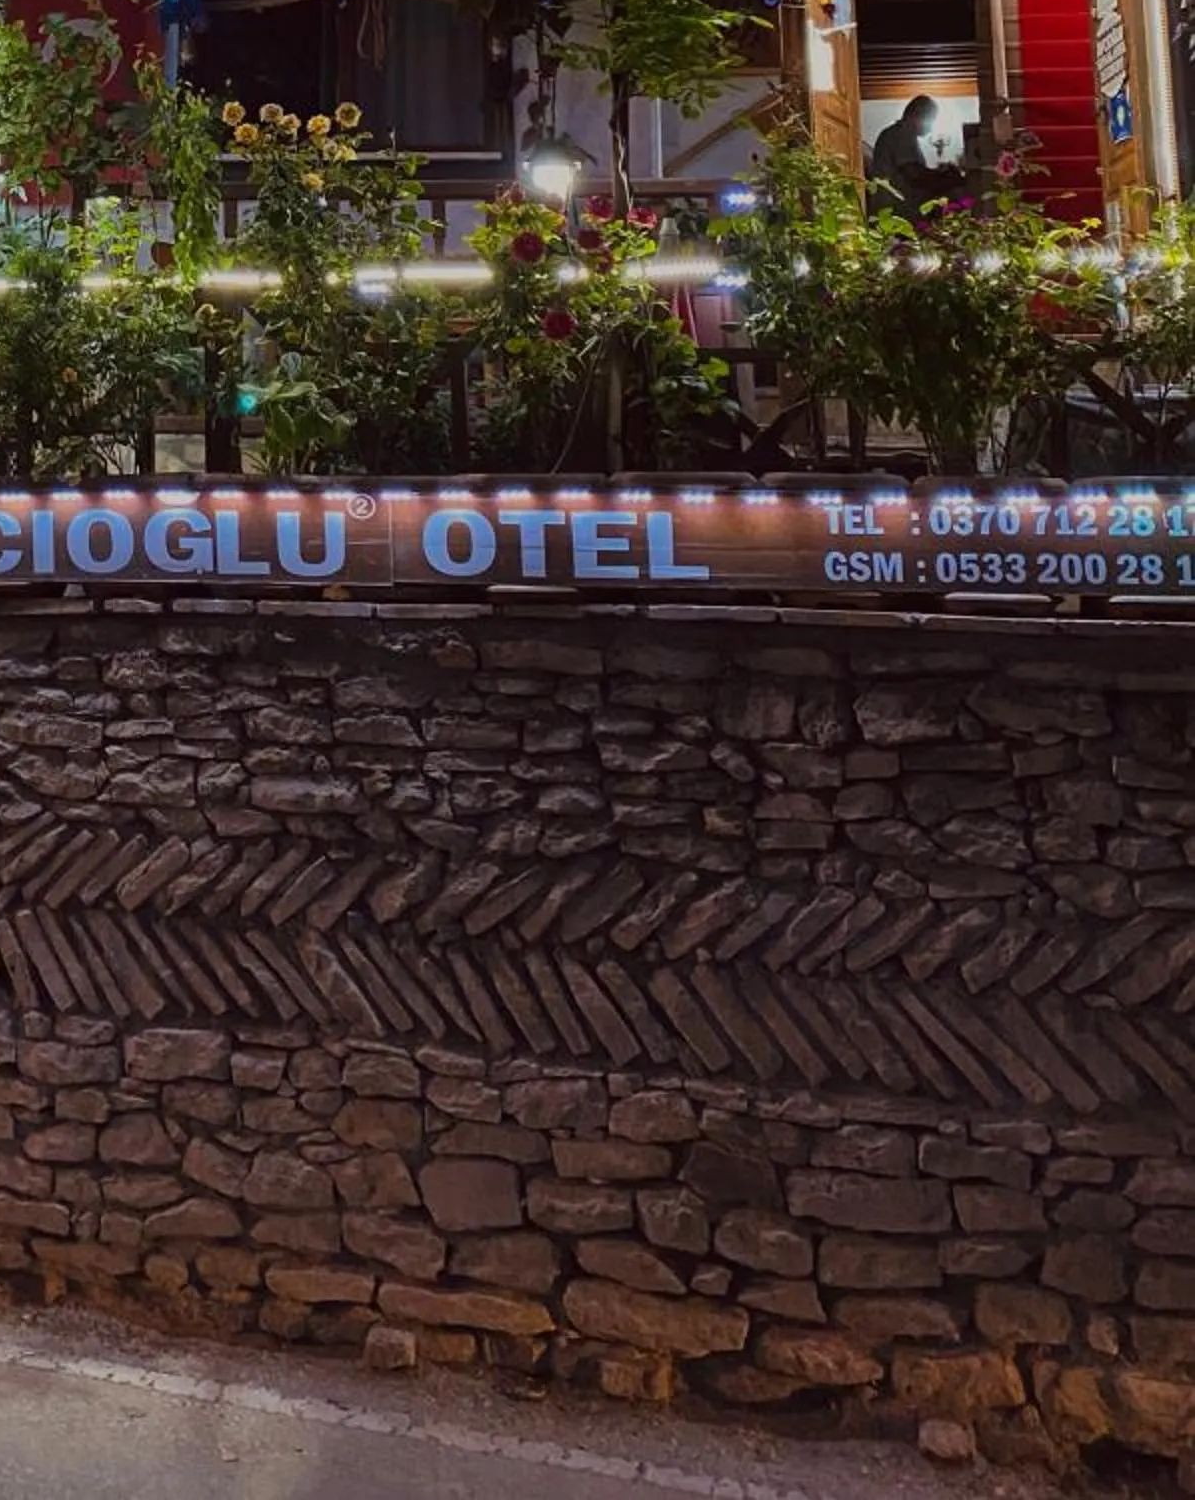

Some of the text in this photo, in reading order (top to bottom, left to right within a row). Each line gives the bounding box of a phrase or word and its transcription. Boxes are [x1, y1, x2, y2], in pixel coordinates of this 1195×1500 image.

[823, 504, 885, 536] TEL
[929, 504, 1021, 536] 0370
[1030, 504, 1098, 537] 712
[1107, 504, 1156, 537] 28
[422, 508, 709, 581] OTEL
[824, 550, 905, 584] GSM
[936, 552, 1027, 584] 0533
[1037, 552, 1108, 585] 200
[1116, 553, 1165, 586] 28
